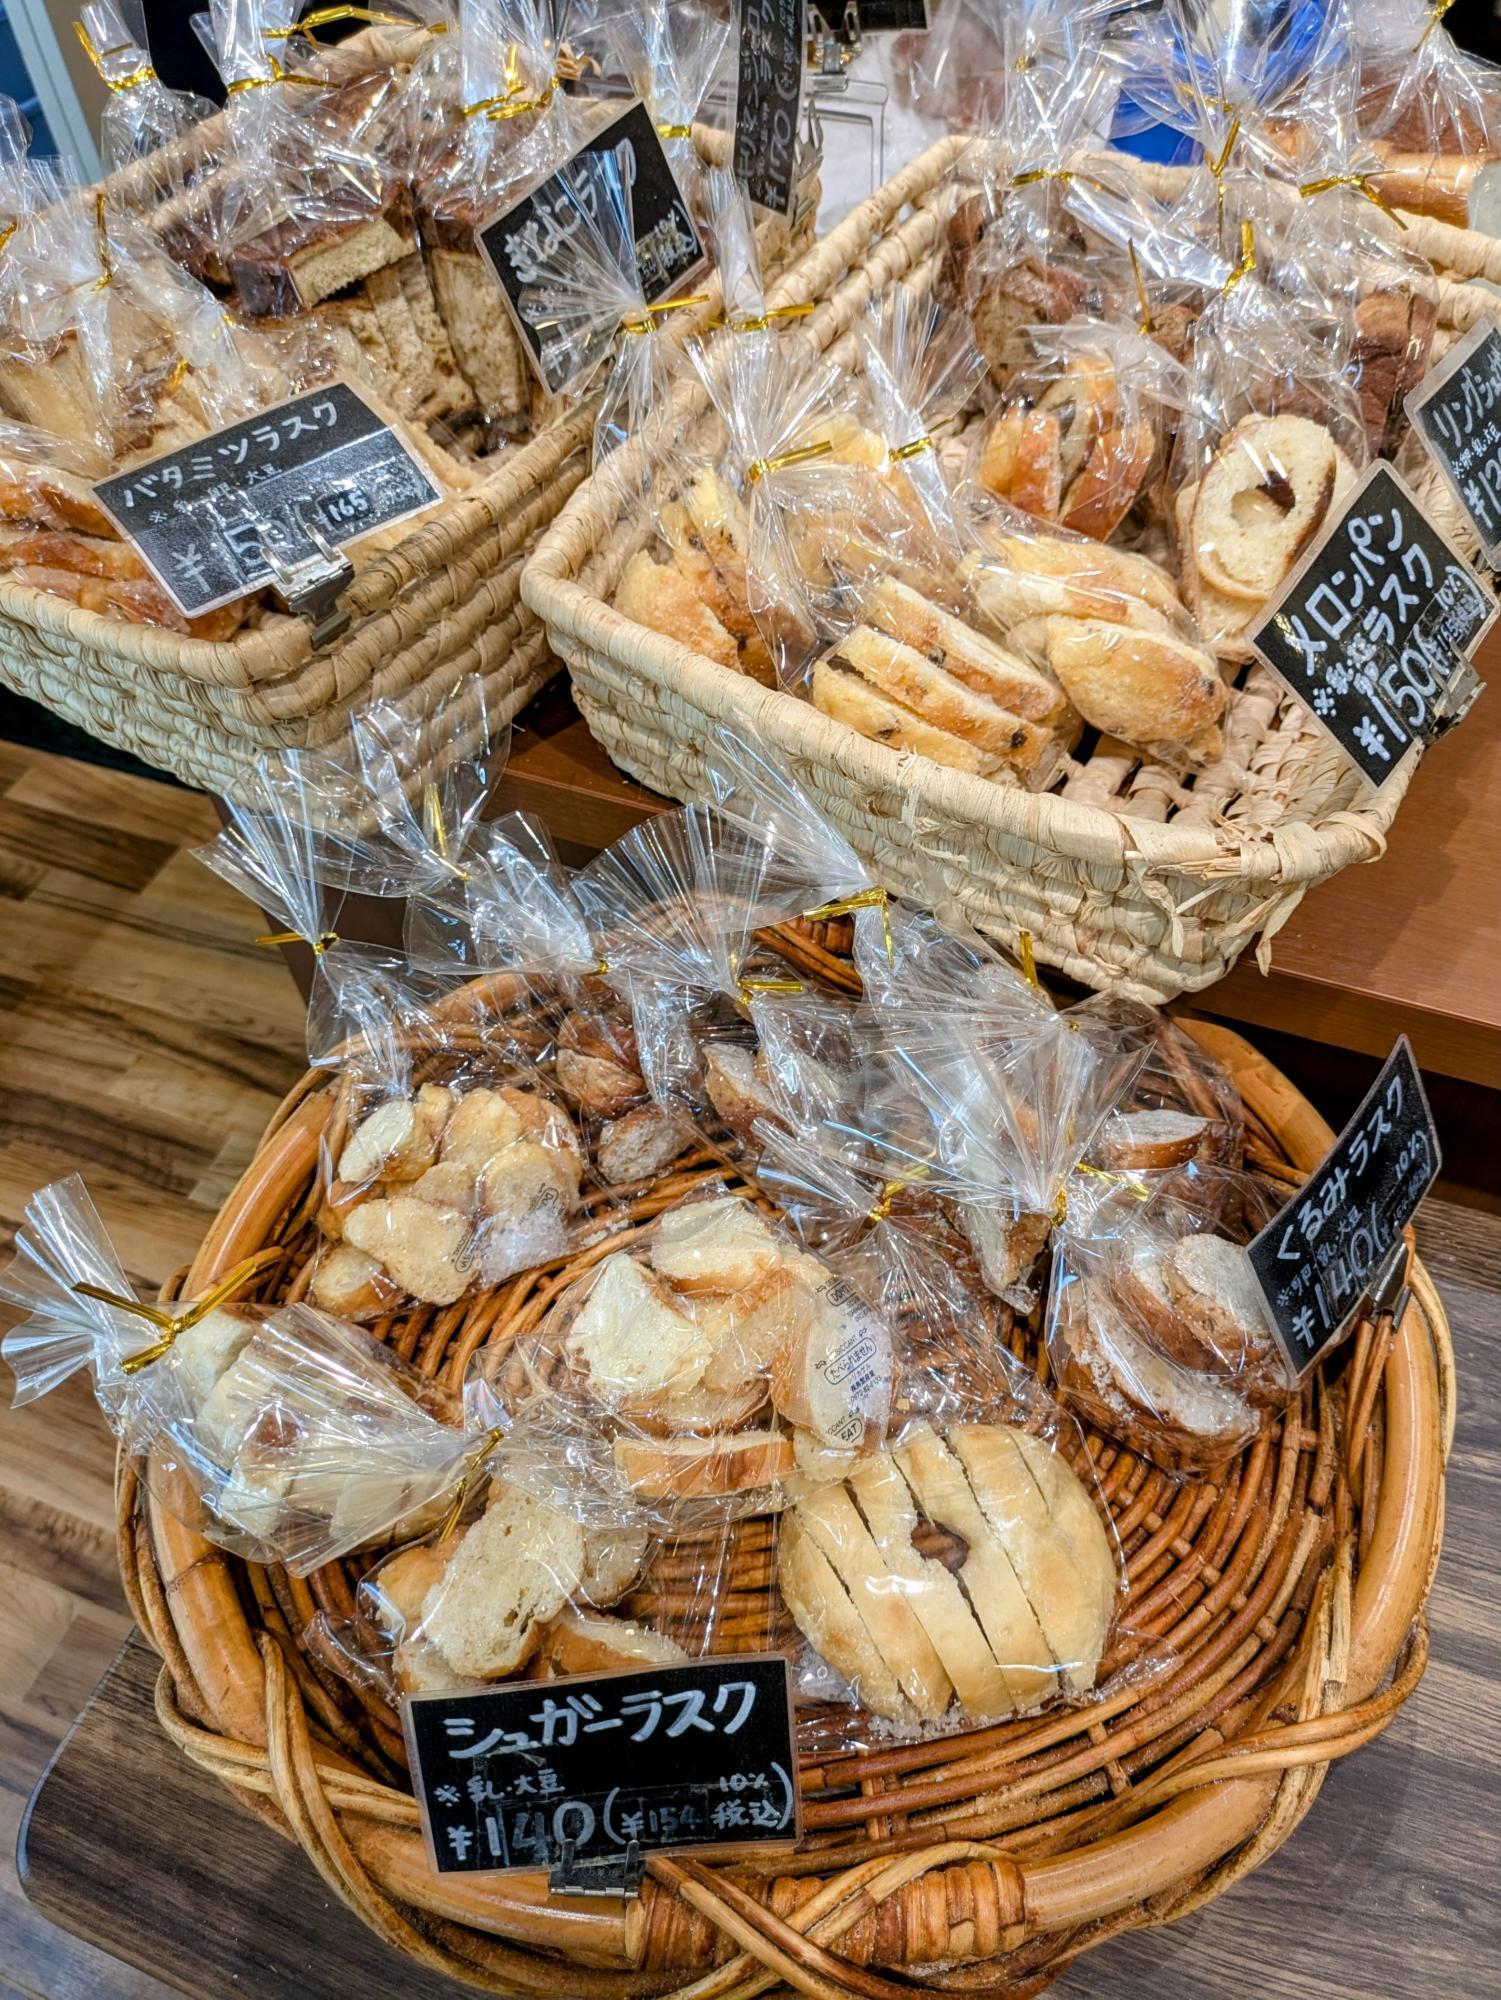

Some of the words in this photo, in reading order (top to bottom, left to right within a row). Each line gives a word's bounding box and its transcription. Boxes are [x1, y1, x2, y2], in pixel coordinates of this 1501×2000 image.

[1463, 446, 1501, 530] ¥12
[1284, 507, 1404, 677] メロンパン
[1363, 543, 1434, 646] ラスク
[1276, 1074, 1402, 1261] くるみラスク
[841, 1422, 858, 1441] EAT
[443, 1681, 757, 1759] シュガーラスク
[447, 1800, 596, 1861] ¥140
